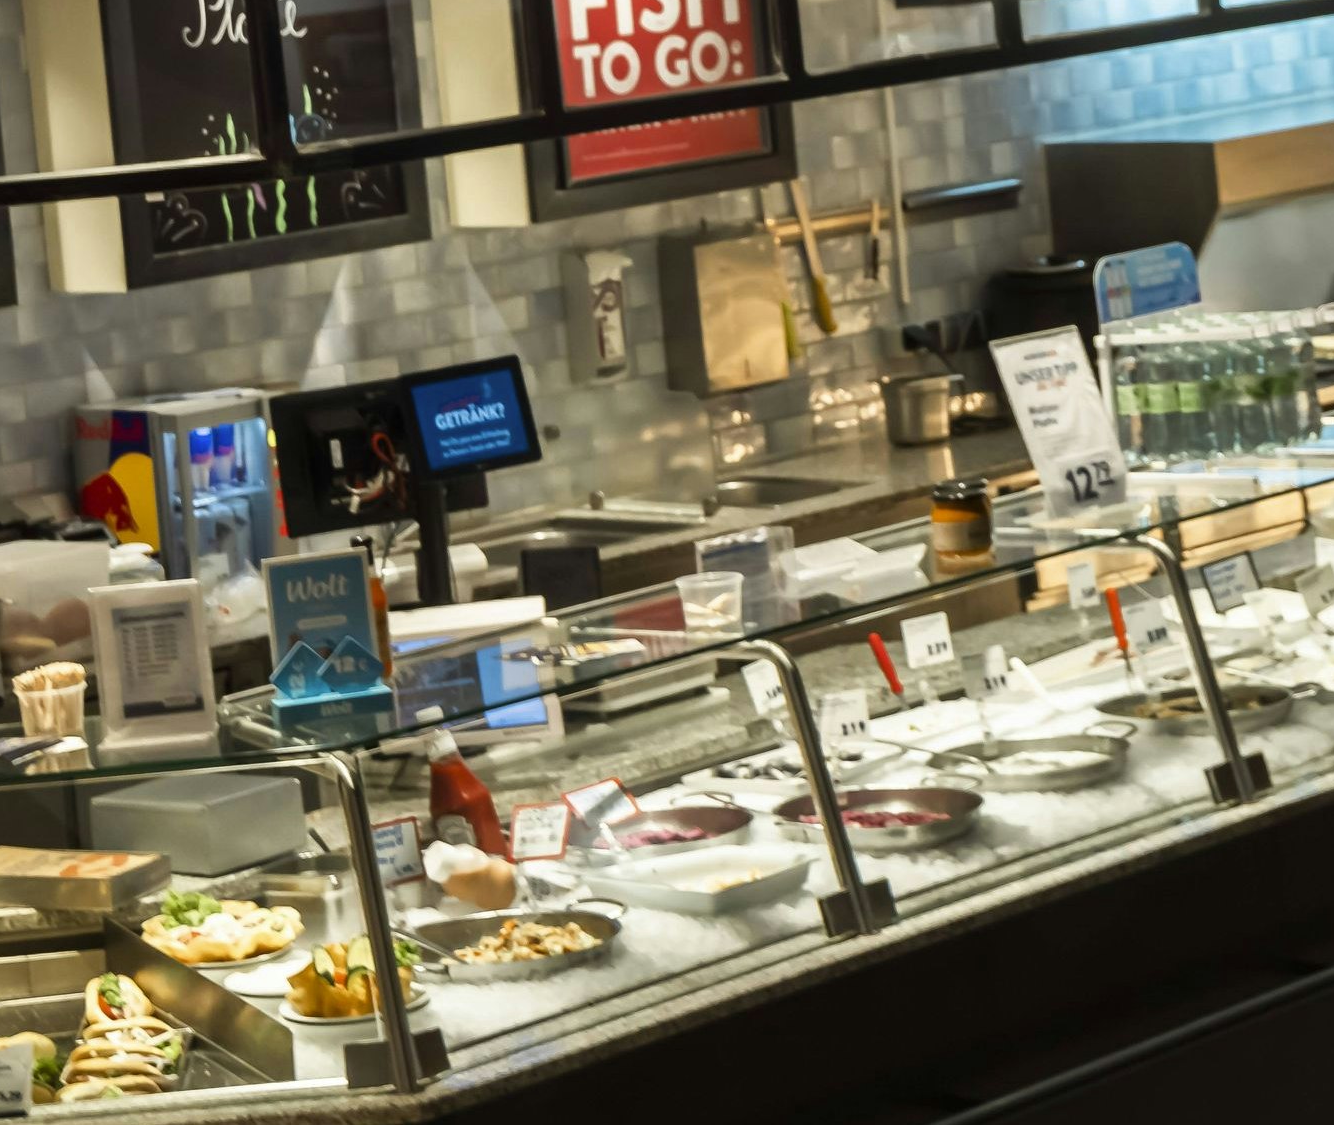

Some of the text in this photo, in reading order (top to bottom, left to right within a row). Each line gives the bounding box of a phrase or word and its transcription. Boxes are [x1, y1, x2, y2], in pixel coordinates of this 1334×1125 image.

[572, 40, 642, 99] TO
[434, 401, 506, 431] GETRÄNK?
[1066, 466, 1099, 503] 12
[286, 573, 348, 603] Wolt
